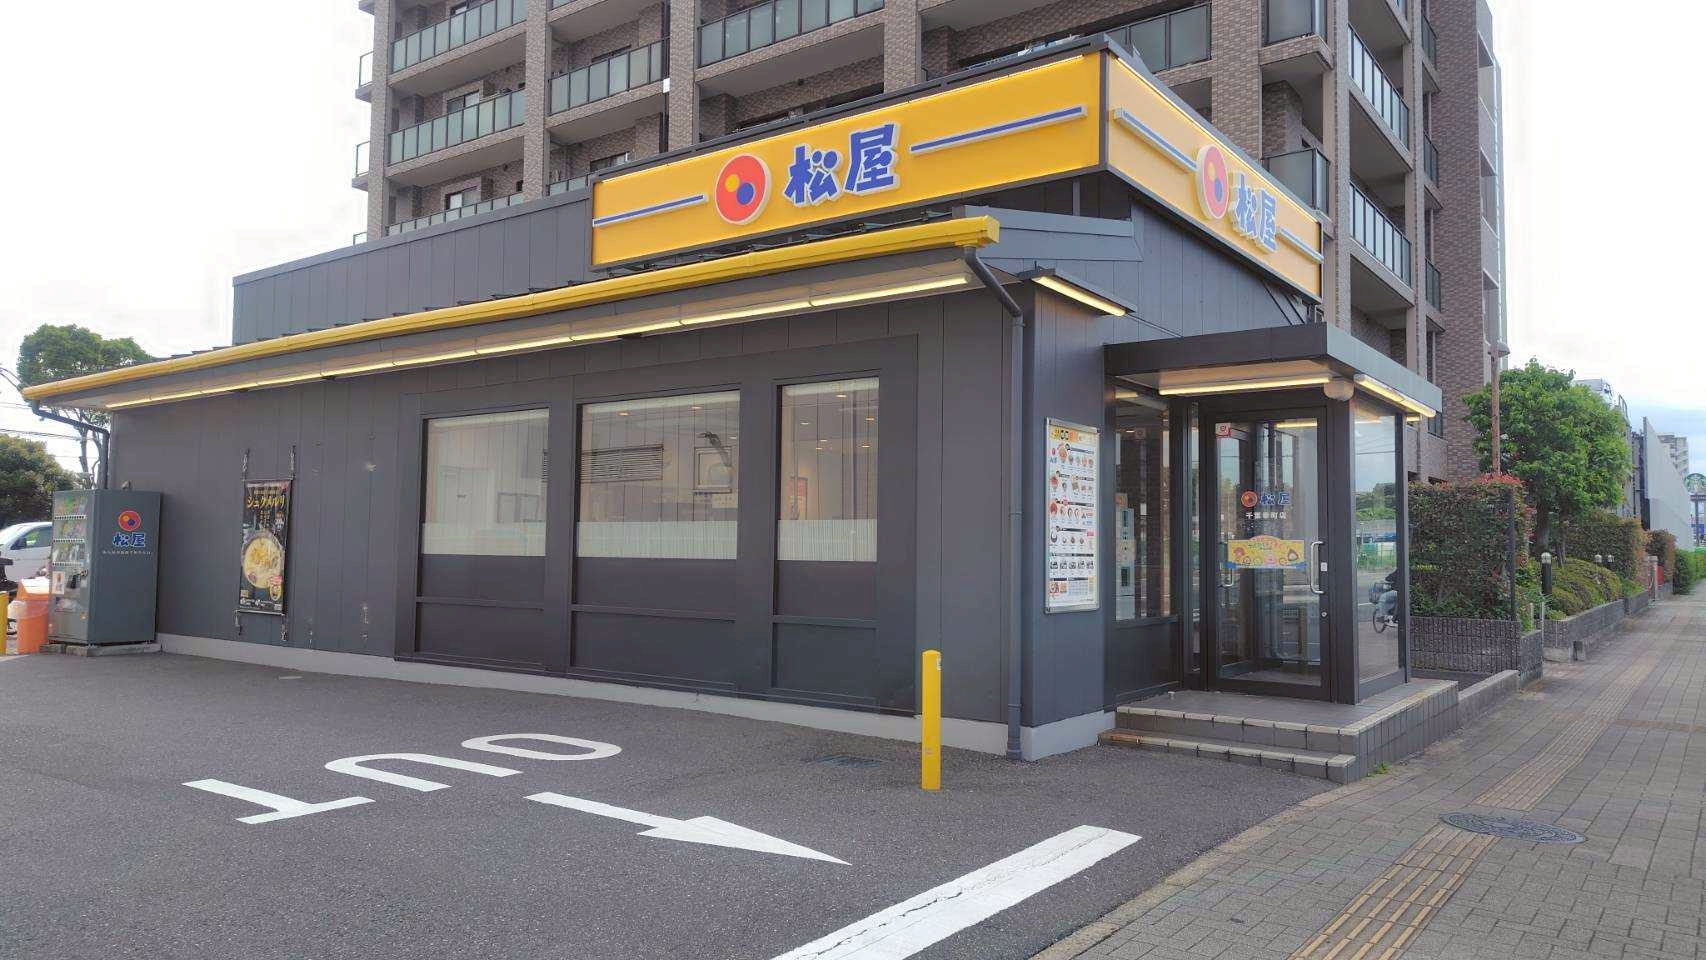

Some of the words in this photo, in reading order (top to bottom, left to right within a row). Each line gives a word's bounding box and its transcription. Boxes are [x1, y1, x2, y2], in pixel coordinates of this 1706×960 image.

[783, 122, 900, 206] 松屋
[1232, 171, 1278, 253] 松屋
[112, 531, 146, 548] 松屋
[1260, 491, 1292, 506] 松屋
[182, 733, 623, 825] OUT
